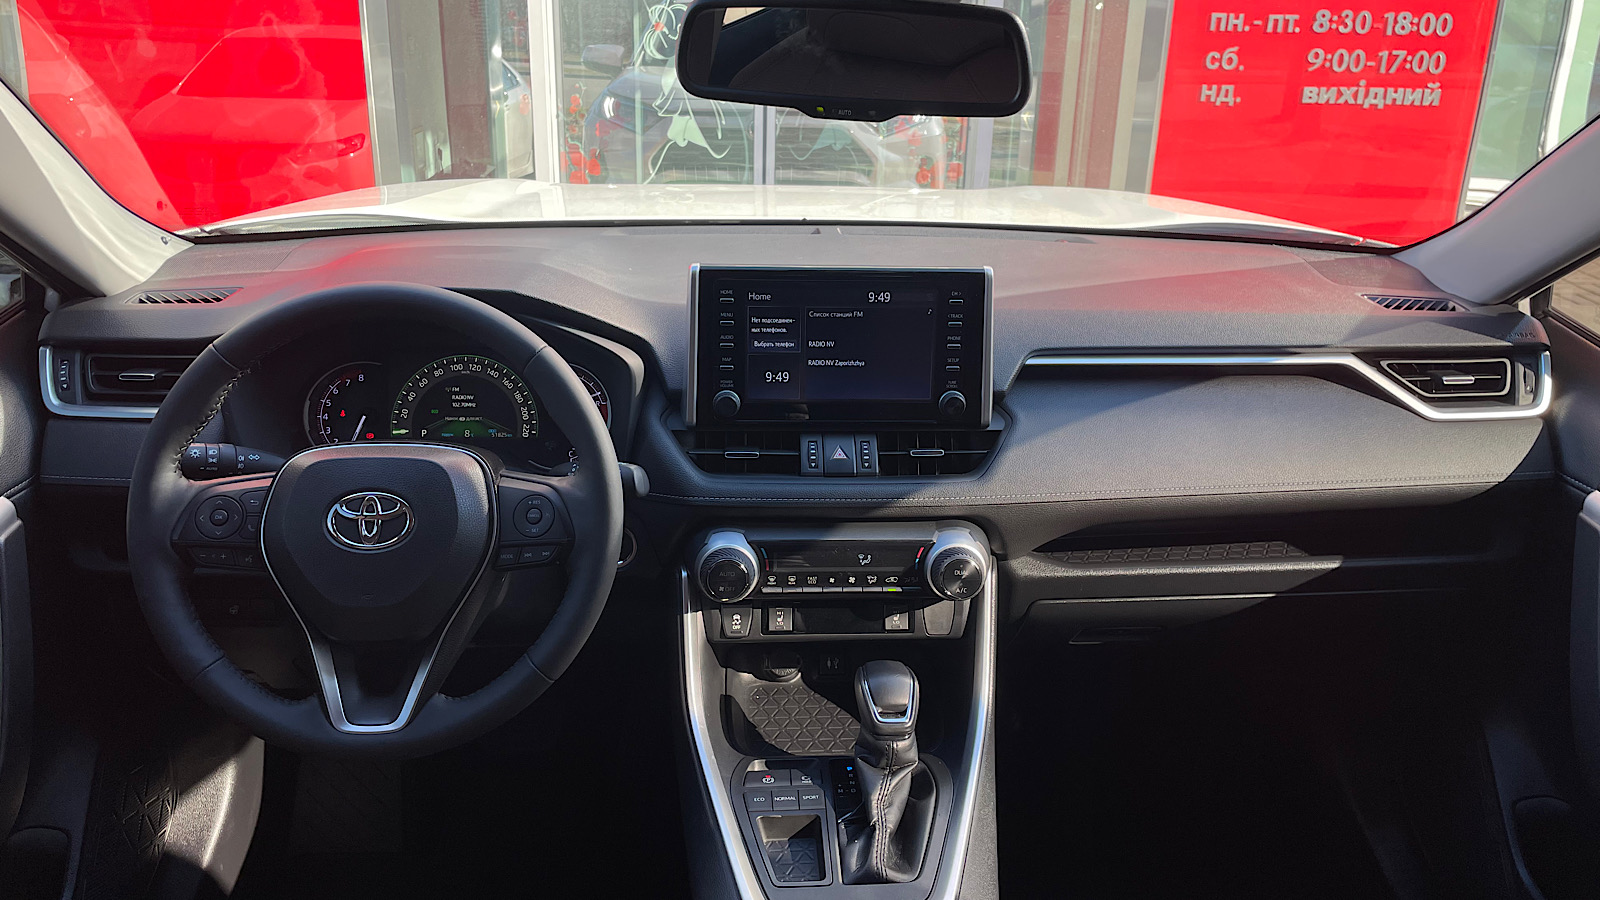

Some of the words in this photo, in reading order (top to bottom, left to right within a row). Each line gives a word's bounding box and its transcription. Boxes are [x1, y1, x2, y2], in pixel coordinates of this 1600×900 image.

[1205, 46, 1244, 71] сб.
[1307, 48, 1446, 74] 9:00-17:00
[1200, 84, 1241, 106] нд.
[1302, 79, 1441, 109] вихідний
[748, 292, 771, 300] Home
[868, 292, 891, 303] 9:49
[433, 368, 444, 377] 80
[450, 364, 463, 372] 100
[468, 364, 482, 372] 120
[486, 368, 499, 378] 140
[358, 374, 364, 382] 8
[765, 371, 789, 382] 9:49
[345, 379, 351, 387] 7
[418, 378, 429, 388] 60
[501, 377, 514, 389] 160
[407, 391, 417, 402] 40
[513, 390, 524, 404] 180
[326, 399, 332, 407] 5
[322, 413, 329, 421] 4
[400, 408, 409, 419] 20
[520, 406, 530, 421] 200
[326, 426, 331, 434] 3
[522, 424, 530, 438] 220
